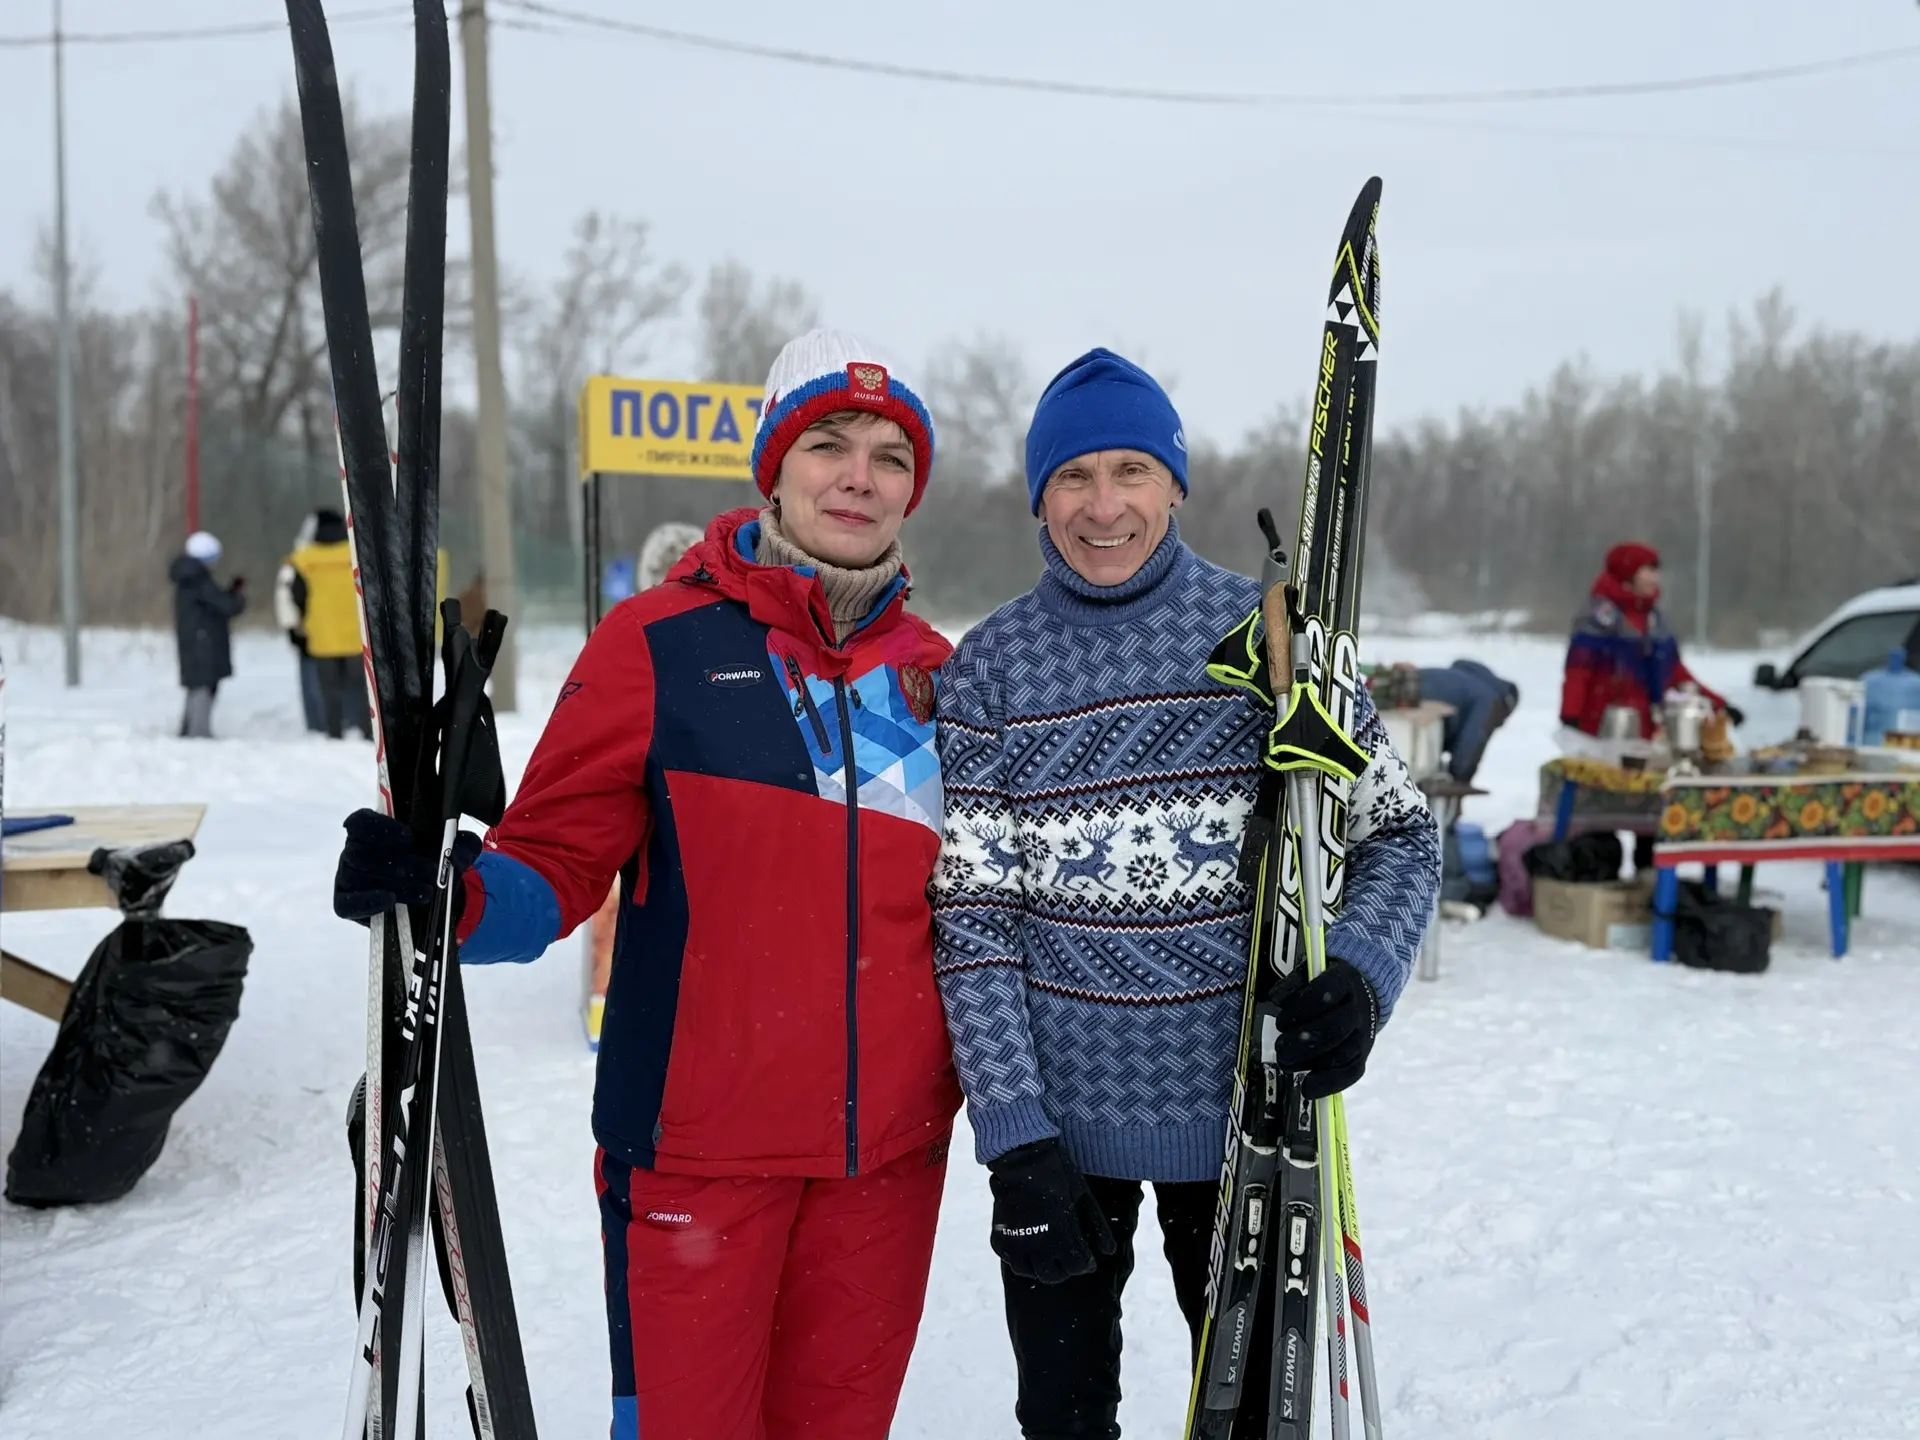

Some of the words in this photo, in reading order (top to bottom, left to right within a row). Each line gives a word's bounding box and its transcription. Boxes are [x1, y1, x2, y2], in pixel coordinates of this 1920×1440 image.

[853, 391, 884, 402] RUSSIA
[1311, 330, 1339, 457] FISCHER
[711, 669, 761, 682] FORWARD
[1204, 1067, 1247, 1321] FISCHER
[646, 1212, 692, 1223] FORWARD
[1002, 1223, 1049, 1236] MADSHUS
